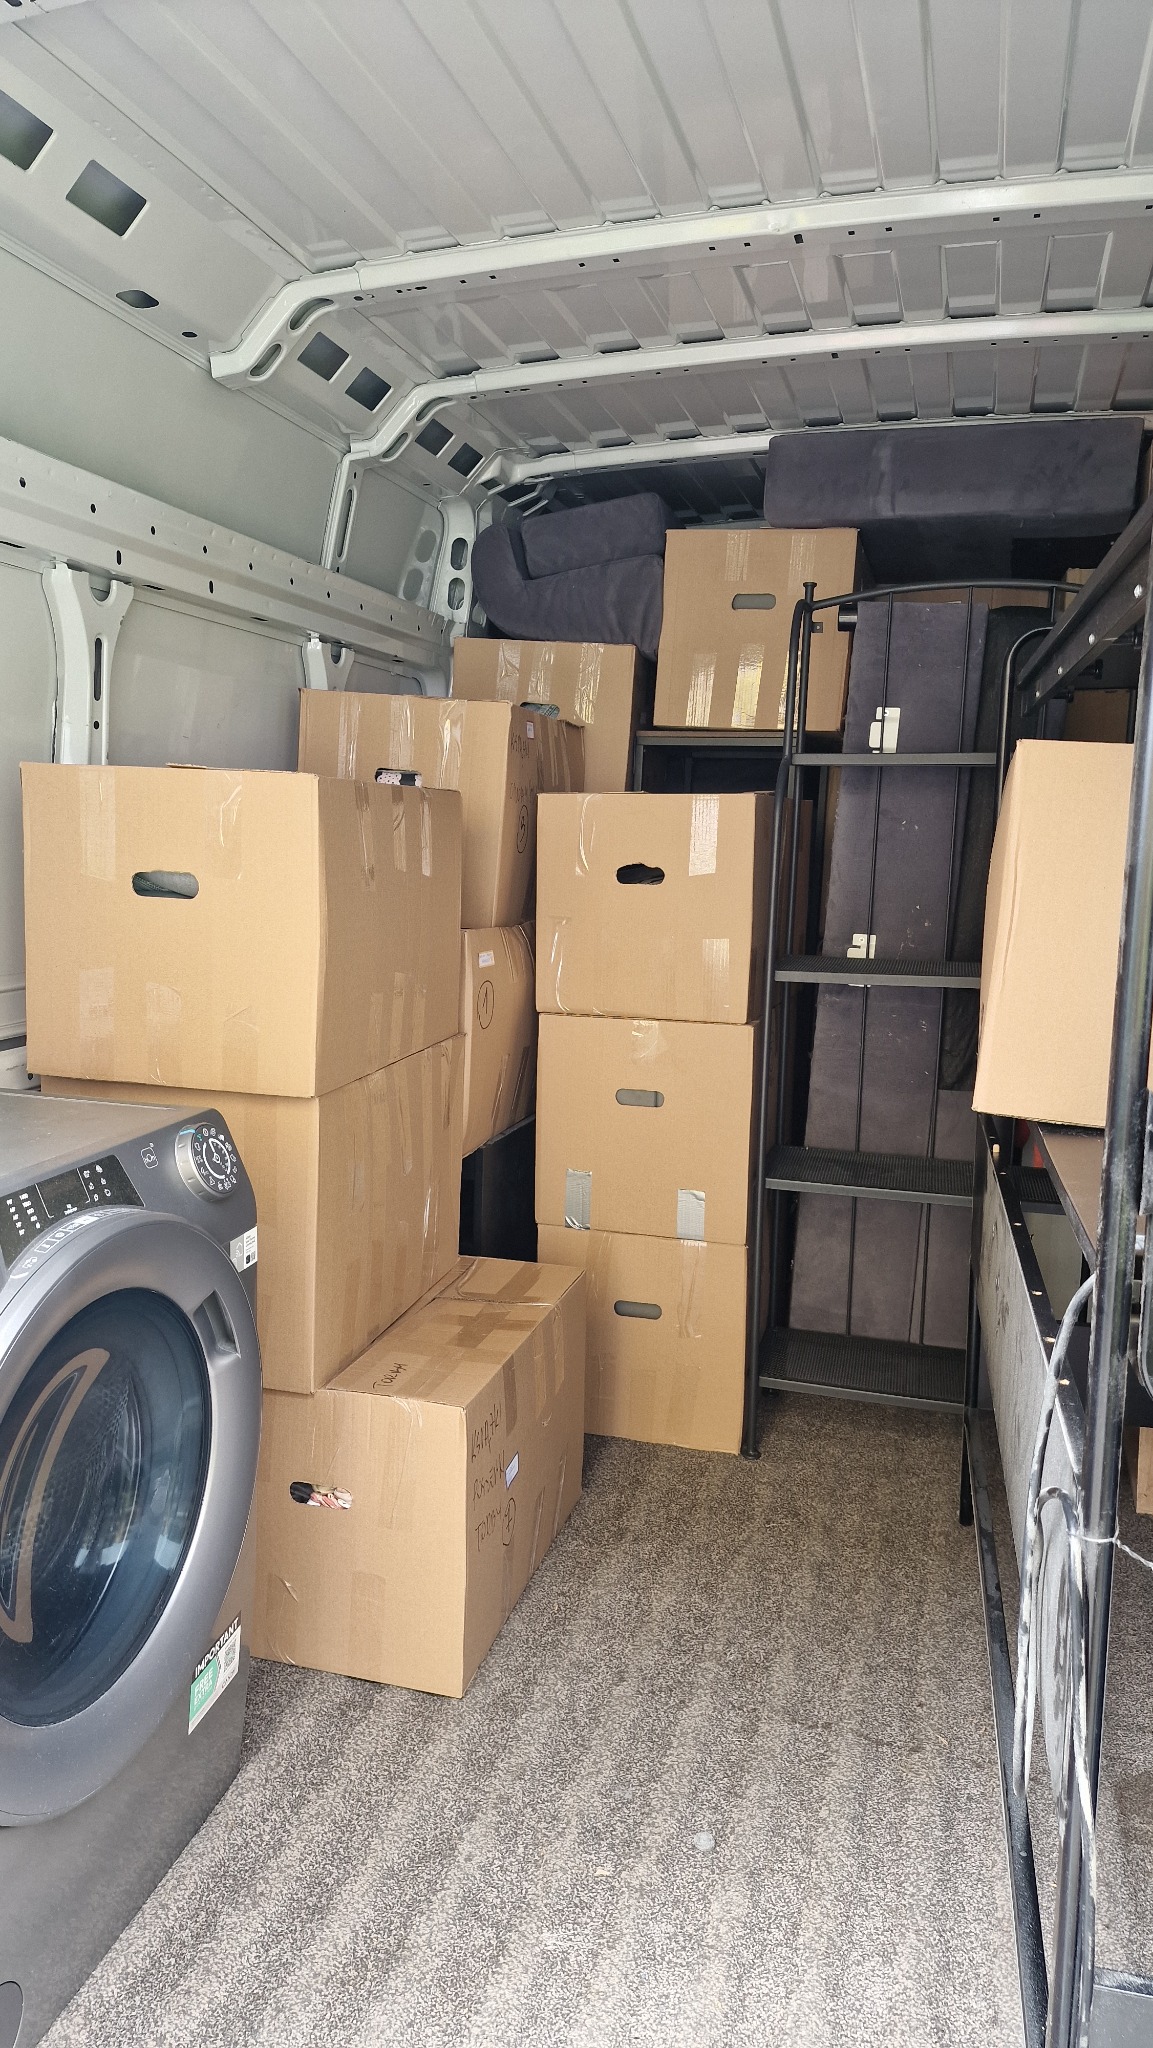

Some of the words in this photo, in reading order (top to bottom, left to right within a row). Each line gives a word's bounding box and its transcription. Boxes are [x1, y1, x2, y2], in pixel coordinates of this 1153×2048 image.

[194, 1616, 239, 1678] IMPORTANT
[193, 1678, 213, 1706] EXTRA
[194, 1666, 214, 1696] FREE
